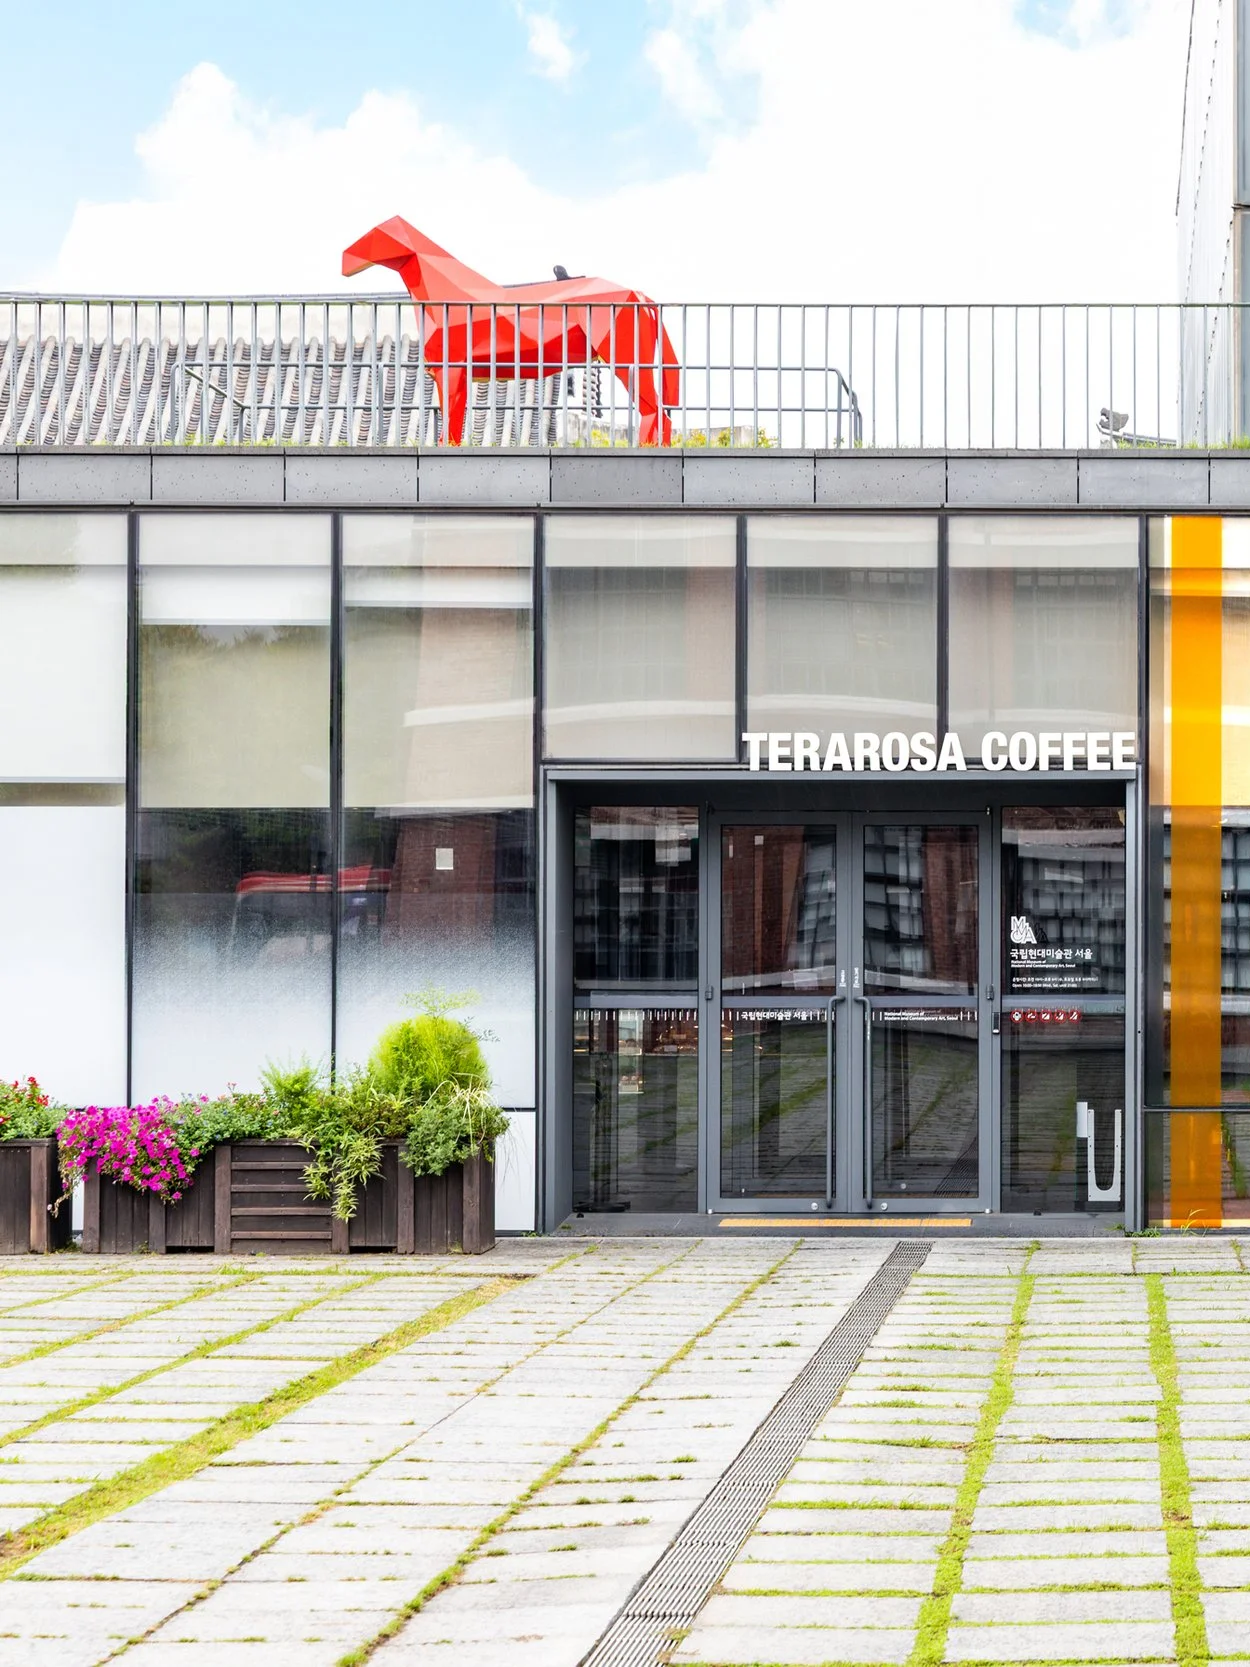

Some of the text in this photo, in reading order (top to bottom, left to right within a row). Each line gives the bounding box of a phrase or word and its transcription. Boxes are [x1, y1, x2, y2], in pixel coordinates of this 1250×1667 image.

[742, 731, 1137, 772] TERAROSA COFFEE
[1010, 948, 1093, 960] 국립현대미술관 서울
[741, 1010, 808, 1021] 국립현대미술관 서울
